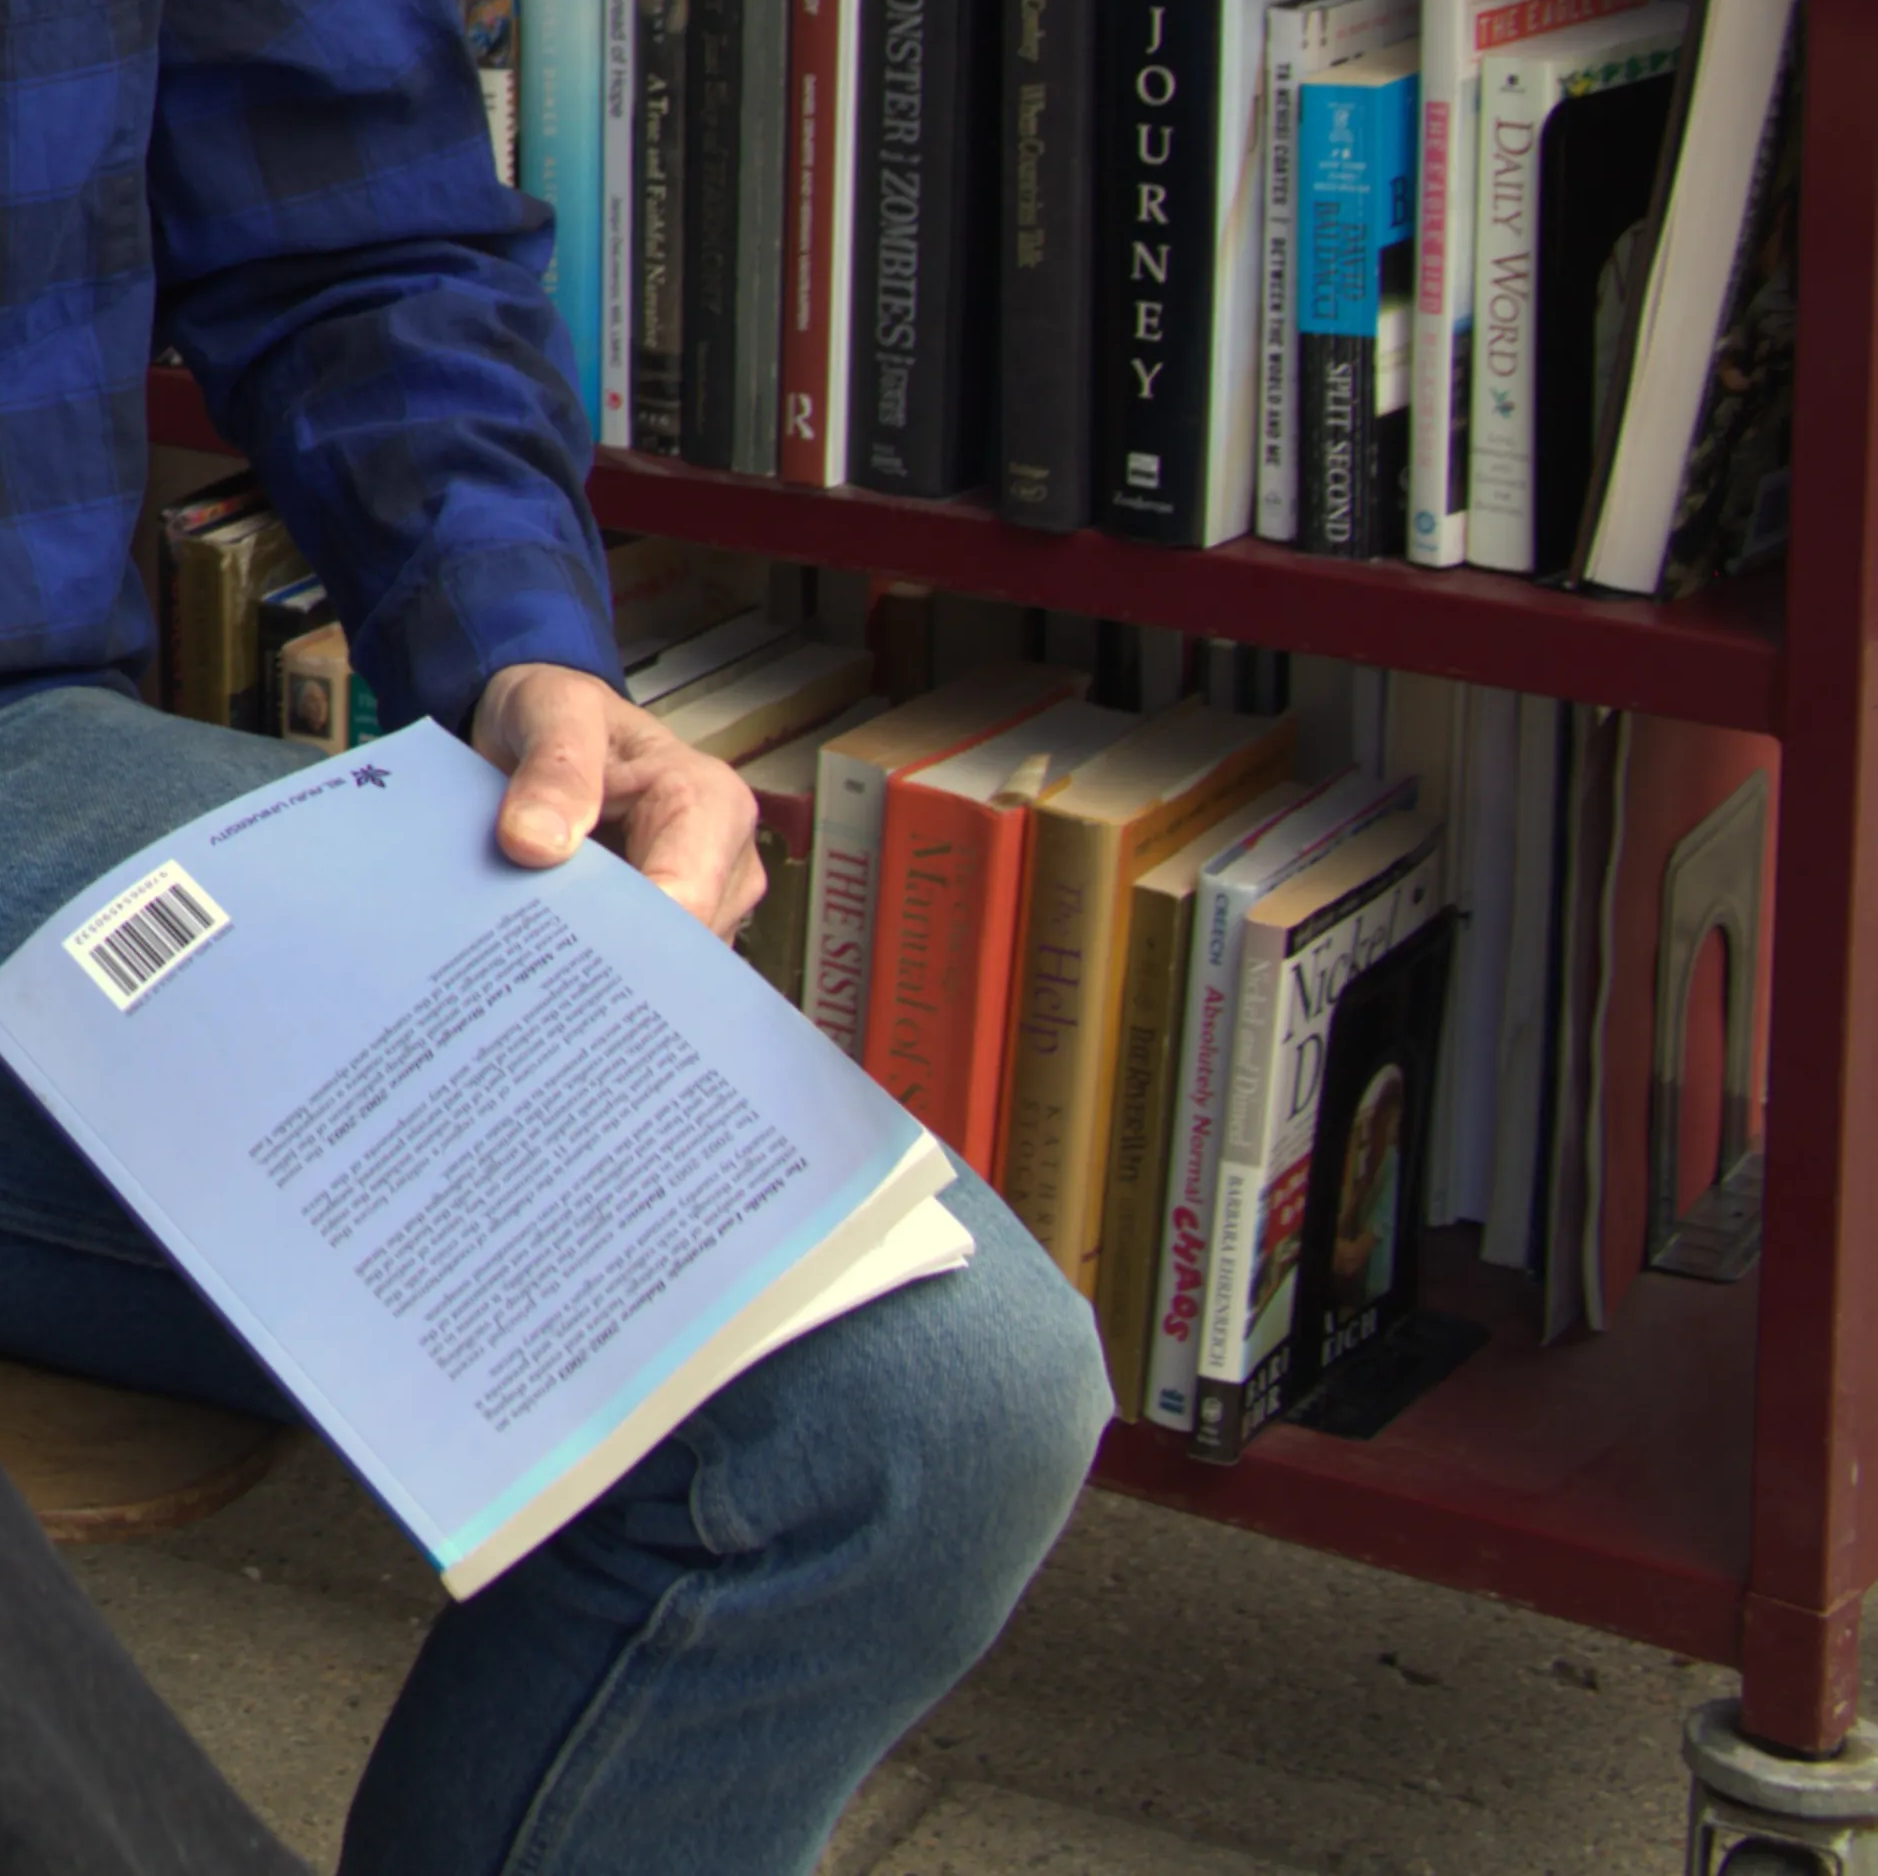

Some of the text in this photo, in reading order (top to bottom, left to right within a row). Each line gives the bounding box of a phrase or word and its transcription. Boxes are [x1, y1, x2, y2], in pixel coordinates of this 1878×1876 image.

[610, 46, 628, 64] of
[1479, 7, 1520, 46] THE
[606, 69, 628, 119] Hope
[1019, 82, 1049, 137] When
[642, 73, 670, 348] A True and Faithful Narrative
[1420, 106, 1448, 314] THE EAGLE BIRD
[1491, 118, 1535, 237] DAILY
[701, 159, 727, 315] HARMONY
[874, 168, 921, 350] ZOMBIES
[1311, 201, 1339, 320] BALDACCI
[1339, 223, 1367, 301] DAVID
[1264, 144, 1289, 467] COATES BETWEEN THE WORLD AND ME
[1485, 251, 1532, 378] WORD
[1321, 361, 1354, 543] SPLIT SECOND
[823, 848, 871, 931] THE
[511, 949, 554, 988] Middle
[554, 932, 578, 954] The
[888, 831, 953, 1068] Manual of
[1019, 882, 1084, 1056] The Help
[432, 1003, 487, 1052] Strategic
[485, 983, 514, 1010] East
[387, 1048, 437, 1093] Balance
[1228, 957, 1272, 1147] Nickel and Dimed
[1161, 892, 1232, 1344] CREECH Absolutely Normal CHAOS
[741, 1176, 786, 1216] Middle
[783, 1156, 809, 1180] The
[663, 1232, 718, 1282] Strategic
[715, 1210, 745, 1238] East
[617, 1278, 669, 1324] Balance
[1207, 1175, 1247, 1369] BARBARA EHRENREICH
